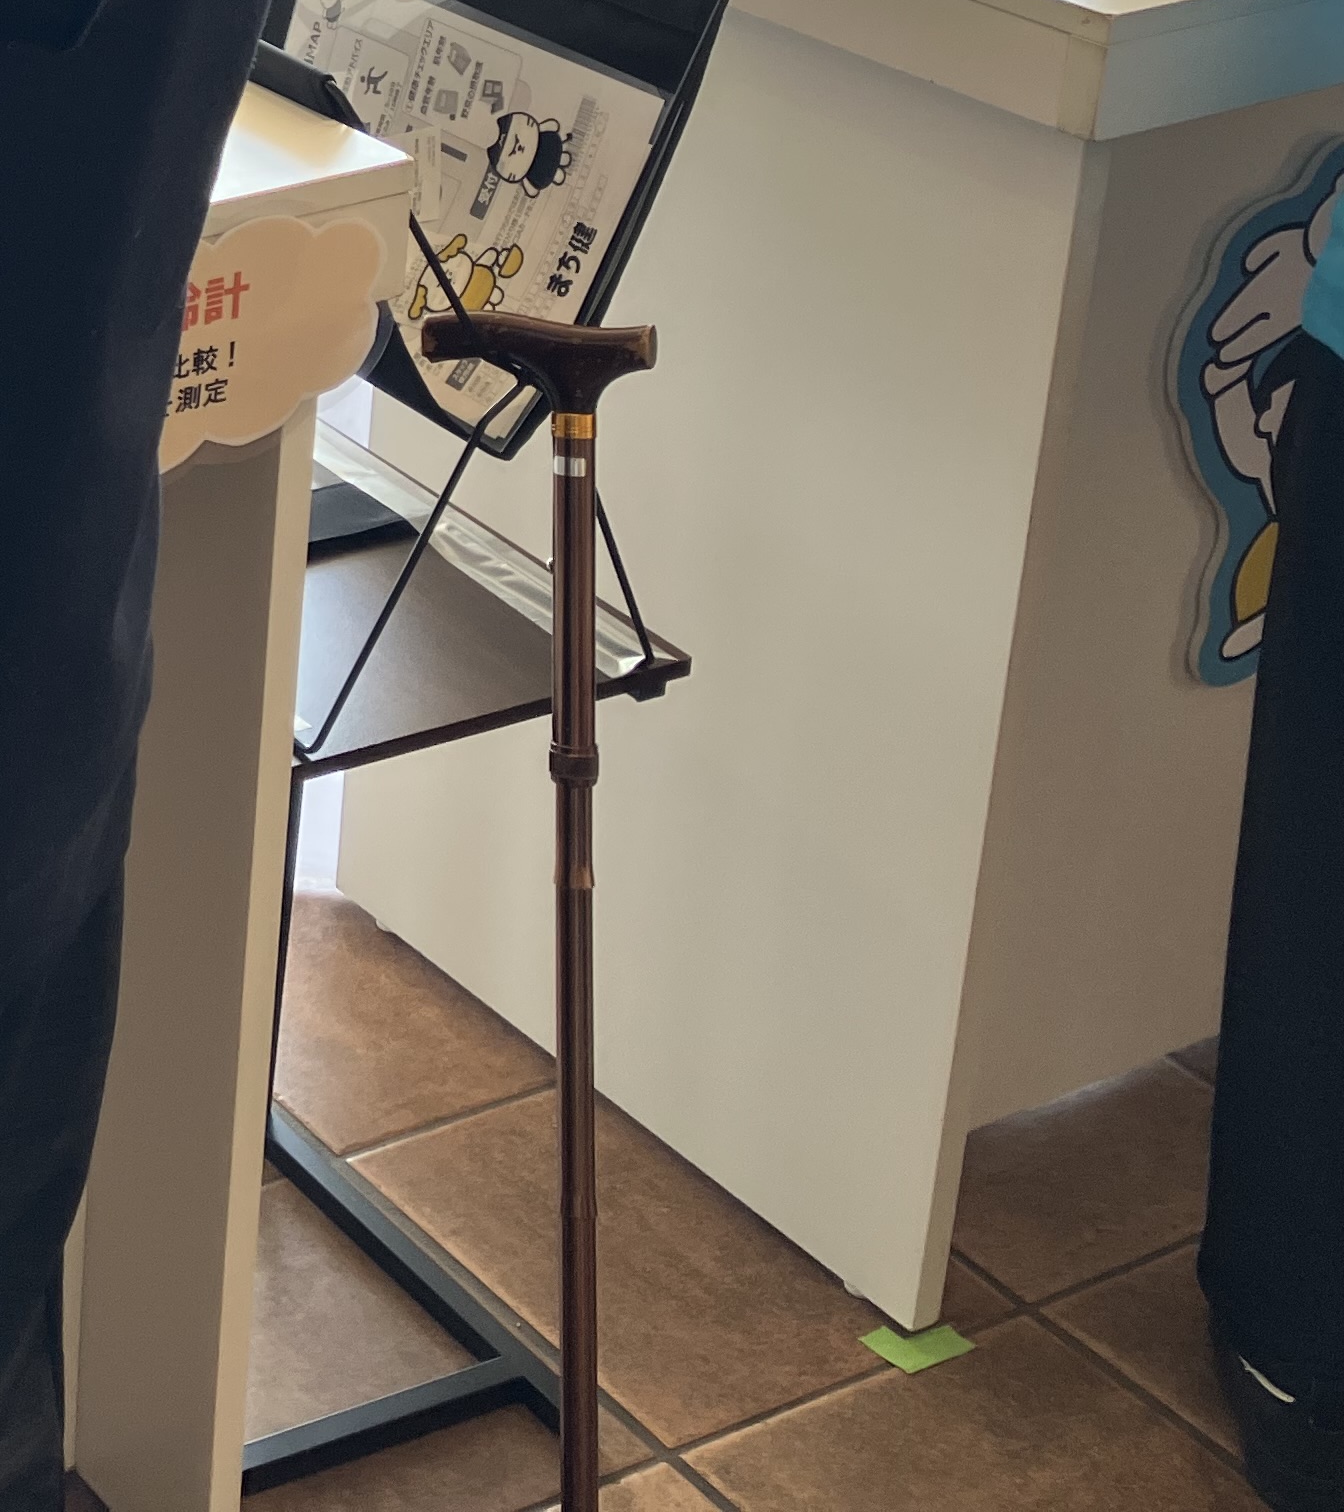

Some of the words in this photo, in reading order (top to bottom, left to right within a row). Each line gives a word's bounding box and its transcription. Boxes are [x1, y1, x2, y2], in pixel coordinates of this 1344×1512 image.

[477, 172, 500, 205] 受付
[546, 222, 600, 298] まち健
